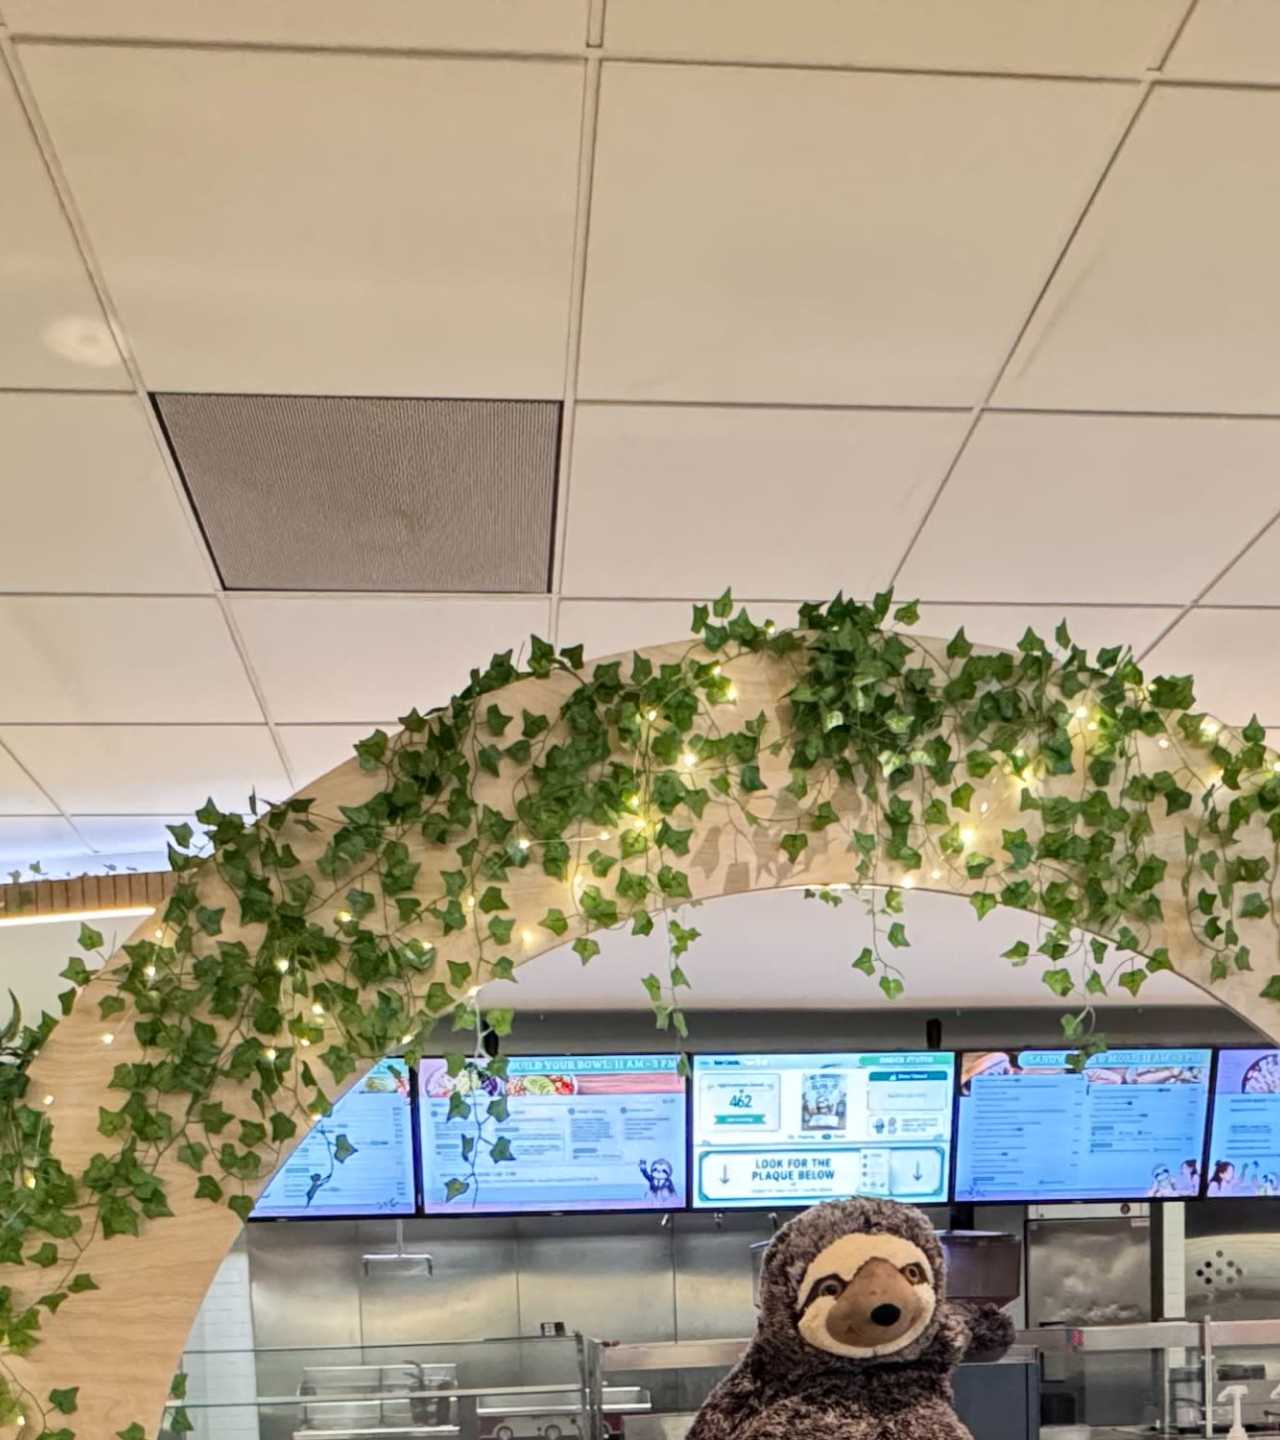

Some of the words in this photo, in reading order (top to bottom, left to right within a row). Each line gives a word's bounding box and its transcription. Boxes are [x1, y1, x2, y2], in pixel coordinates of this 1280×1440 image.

[545, 1060, 576, 1070] YOUR
[578, 1060, 612, 1069] BOWL:
[615, 1059, 625, 1069] 11
[627, 1059, 643, 1069] AM
[729, 1094, 752, 1108] 462
[755, 1158, 783, 1169] LOOK
[787, 1158, 808, 1169] FOR
[812, 1158, 832, 1168] THE
[751, 1170, 795, 1182] PLAQUE
[798, 1170, 835, 1181] BELOW
